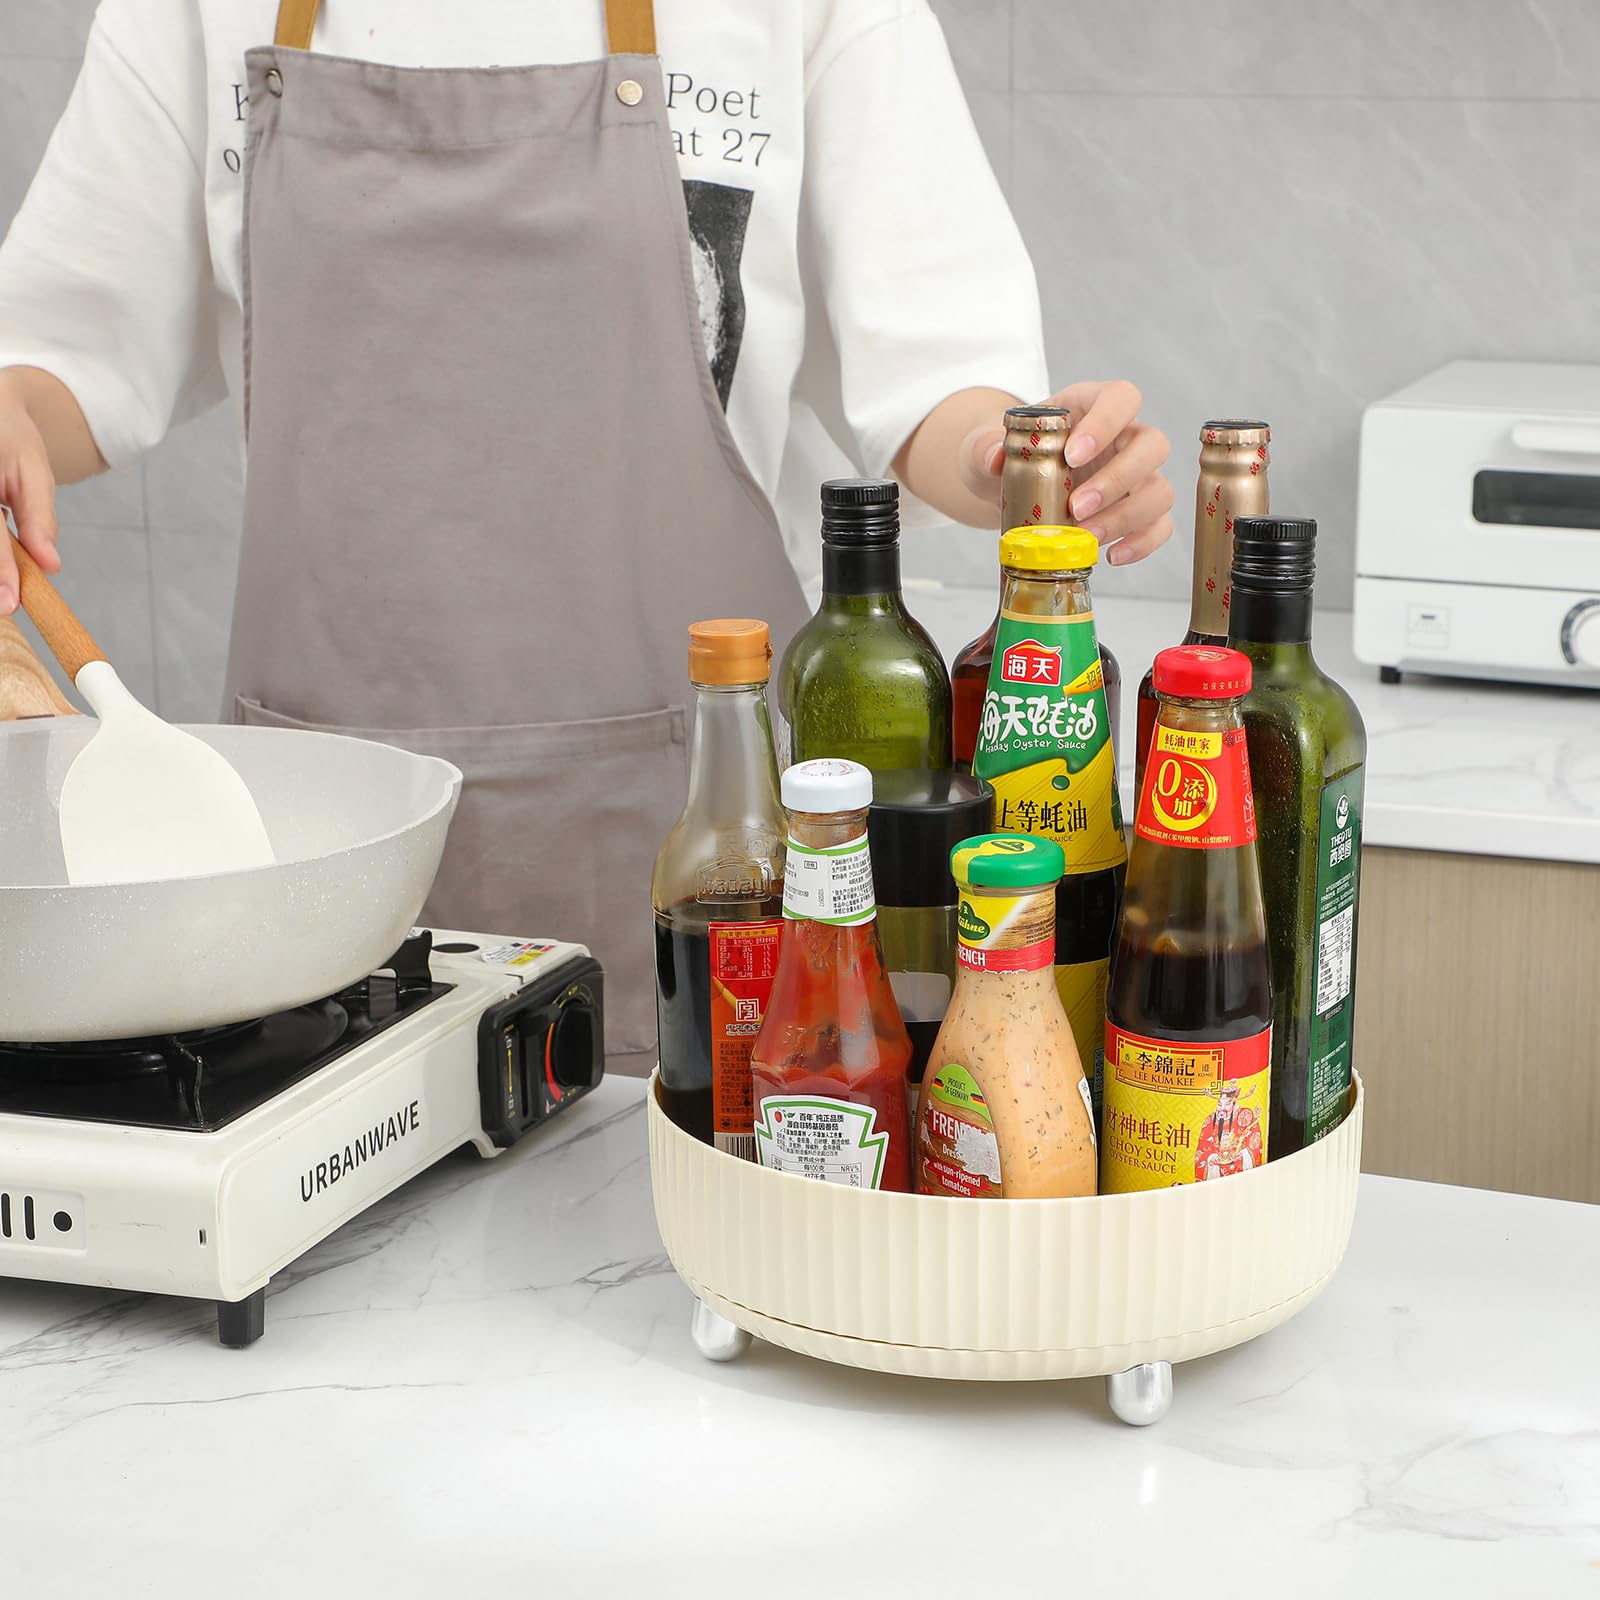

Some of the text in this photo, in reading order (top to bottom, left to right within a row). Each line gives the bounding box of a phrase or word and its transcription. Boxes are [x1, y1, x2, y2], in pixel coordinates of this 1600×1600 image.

[666, 73, 760, 119] Poet
[672, 127, 771, 167] at 27
[1008, 654, 1054, 681] 海天
[1012, 738, 1052, 750] Oyster
[1057, 738, 1086, 749] Sauce
[1165, 732, 1211, 750] 蚝油世家
[996, 799, 1089, 833] 上等蚝油
[957, 916, 985, 934] ühne
[1136, 1052, 1195, 1077] 李錦記
[948, 1077, 966, 1091] PRODUCT
[1134, 1071, 1149, 1083] LEE
[1151, 1074, 1173, 1087] KUM
[1176, 1077, 1195, 1088] KEE
[950, 1088, 969, 1103] GERMANY
[300, 1099, 420, 1203] URBANWAVE
[1109, 1135, 1177, 1163] CHOY SUN
[1109, 1151, 1176, 1174] OYSTER SAUCE
[941, 1175, 971, 1197] tomatoes
[943, 1165, 981, 1187] sun-ripened
